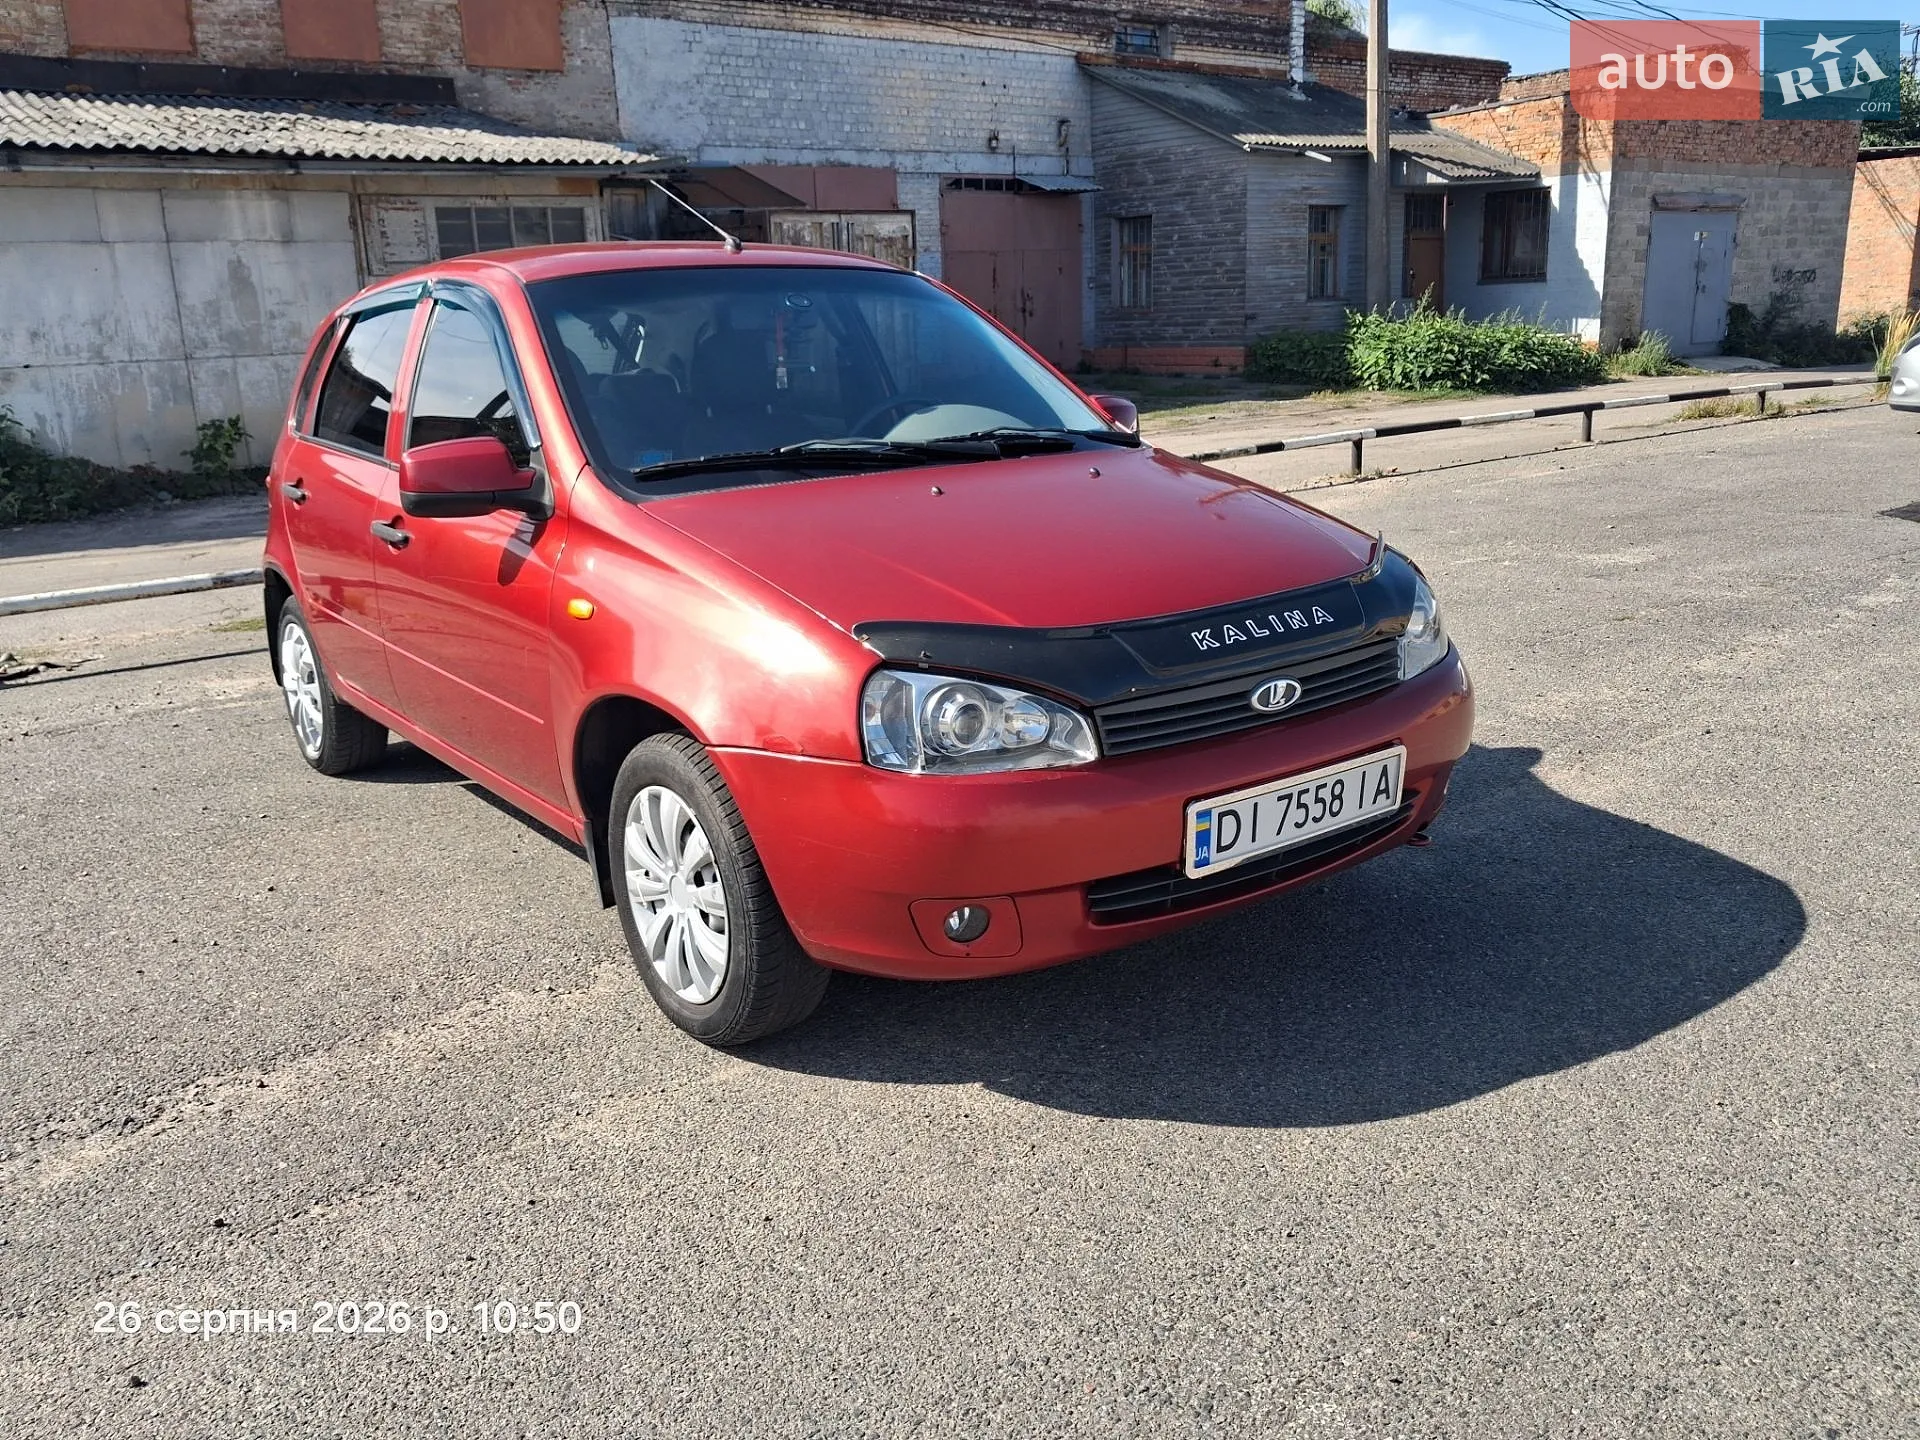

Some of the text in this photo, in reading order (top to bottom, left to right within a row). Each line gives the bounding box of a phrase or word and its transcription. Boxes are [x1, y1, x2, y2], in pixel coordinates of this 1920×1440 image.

[1191, 606, 1334, 650] KALINA
[1216, 764, 1391, 854] DI 7558 IA
